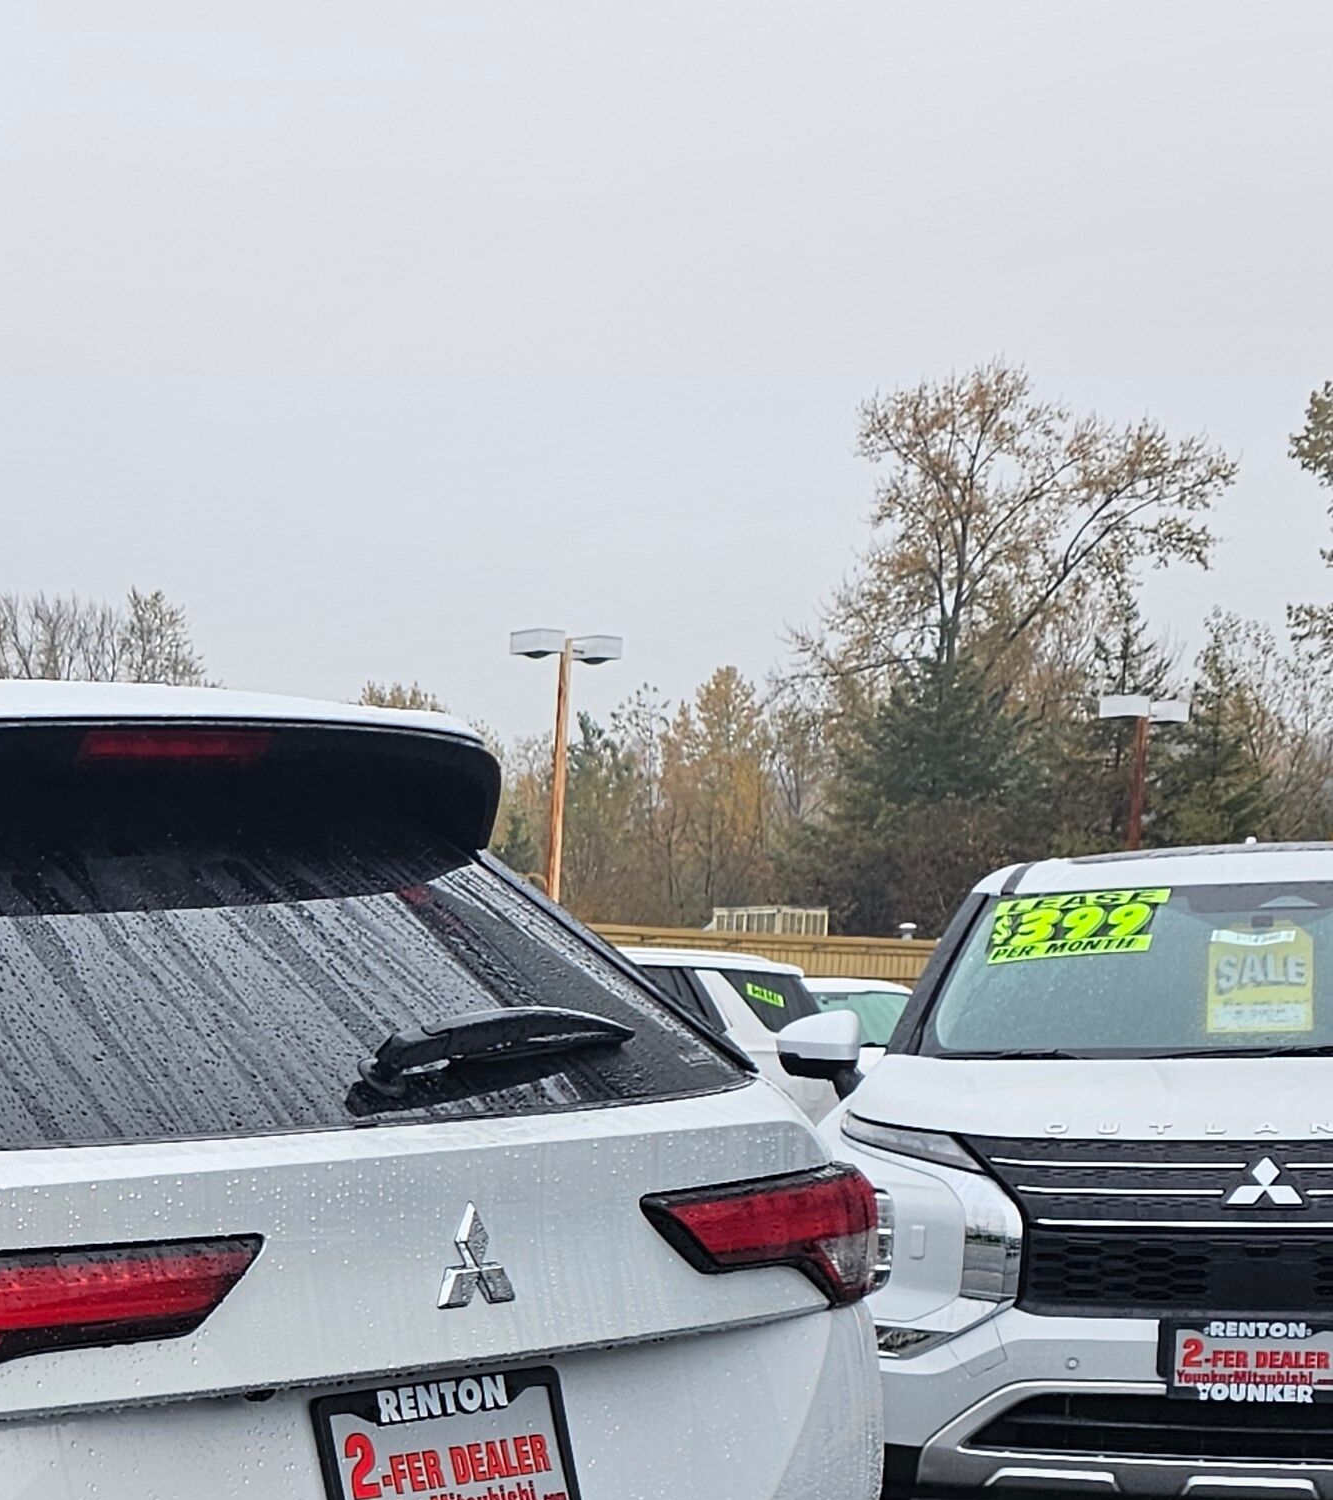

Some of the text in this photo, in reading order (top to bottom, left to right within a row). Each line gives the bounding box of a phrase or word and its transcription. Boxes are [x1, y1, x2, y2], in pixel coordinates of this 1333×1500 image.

[1006, 890, 1159, 913] LEASE
[992, 903, 1153, 946] $399
[991, 937, 1137, 961] PER MONTH
[1215, 952, 1307, 995] SALE
[1210, 1321, 1306, 1338] RENTON
[1182, 1338, 1330, 1369] 2-FER DEALER
[377, 1375, 508, 1423] RENTON
[1196, 1383, 1313, 1403] YOUNKER
[345, 1432, 552, 1500] 2-FER DEALER
